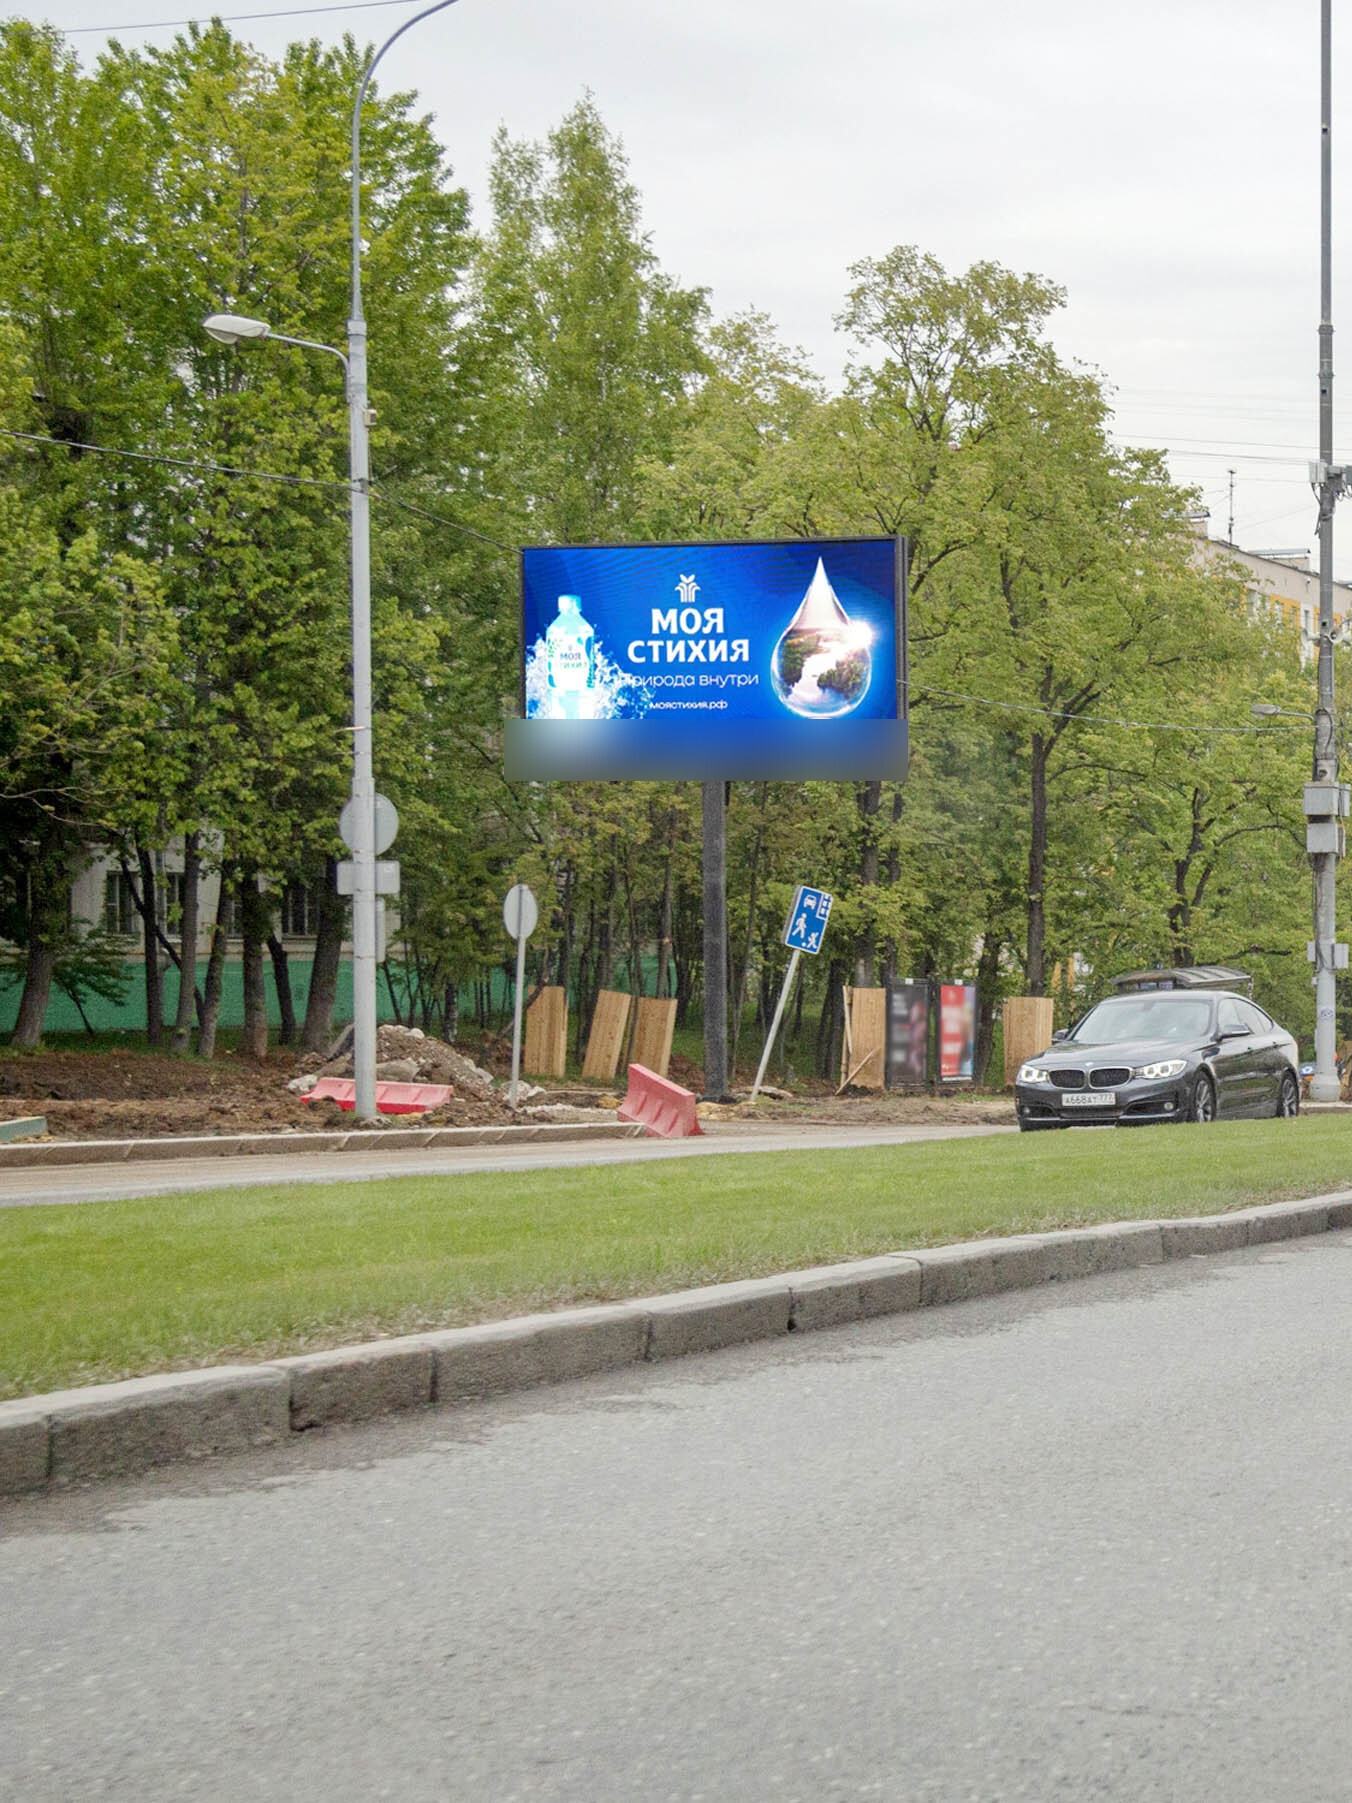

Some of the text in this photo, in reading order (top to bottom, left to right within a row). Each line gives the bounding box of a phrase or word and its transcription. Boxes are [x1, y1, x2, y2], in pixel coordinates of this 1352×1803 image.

[651, 608, 724, 634] МОЯ
[627, 639, 750, 663] СТИХИЯ
[699, 674, 759, 688] внутри
